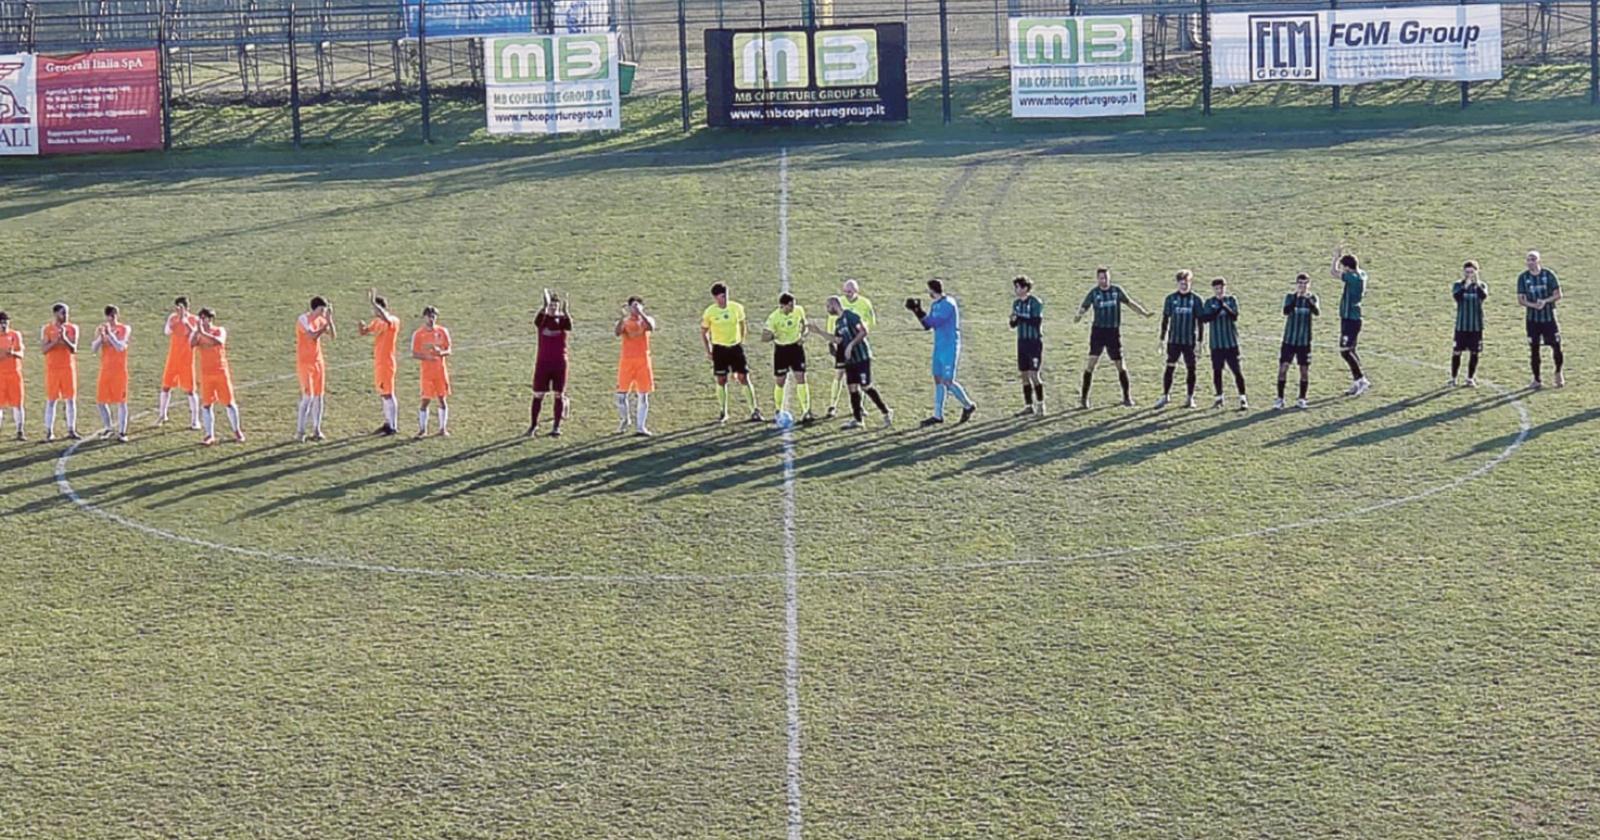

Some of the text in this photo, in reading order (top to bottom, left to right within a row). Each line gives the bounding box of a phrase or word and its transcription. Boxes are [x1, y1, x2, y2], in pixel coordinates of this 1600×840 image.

[1328, 20, 1480, 49] FCM Group
[1256, 21, 1312, 68] FCM
[45, 57, 143, 72] Generali Italia SpA
[1018, 74, 1137, 88] MB COPERTURE GROUP SRL
[1257, 69, 1312, 79] GROUP
[494, 89, 612, 105] MB COPERTURE GROUP SRL
[735, 92, 752, 102] MB
[819, 89, 857, 100] GROUP
[859, 88, 878, 99] SRL
[1019, 92, 1137, 108] www.mbcoperturegroup.it
[495, 108, 612, 124] www.mbcoperturegroup.it
[0, 127, 31, 147] ALI
